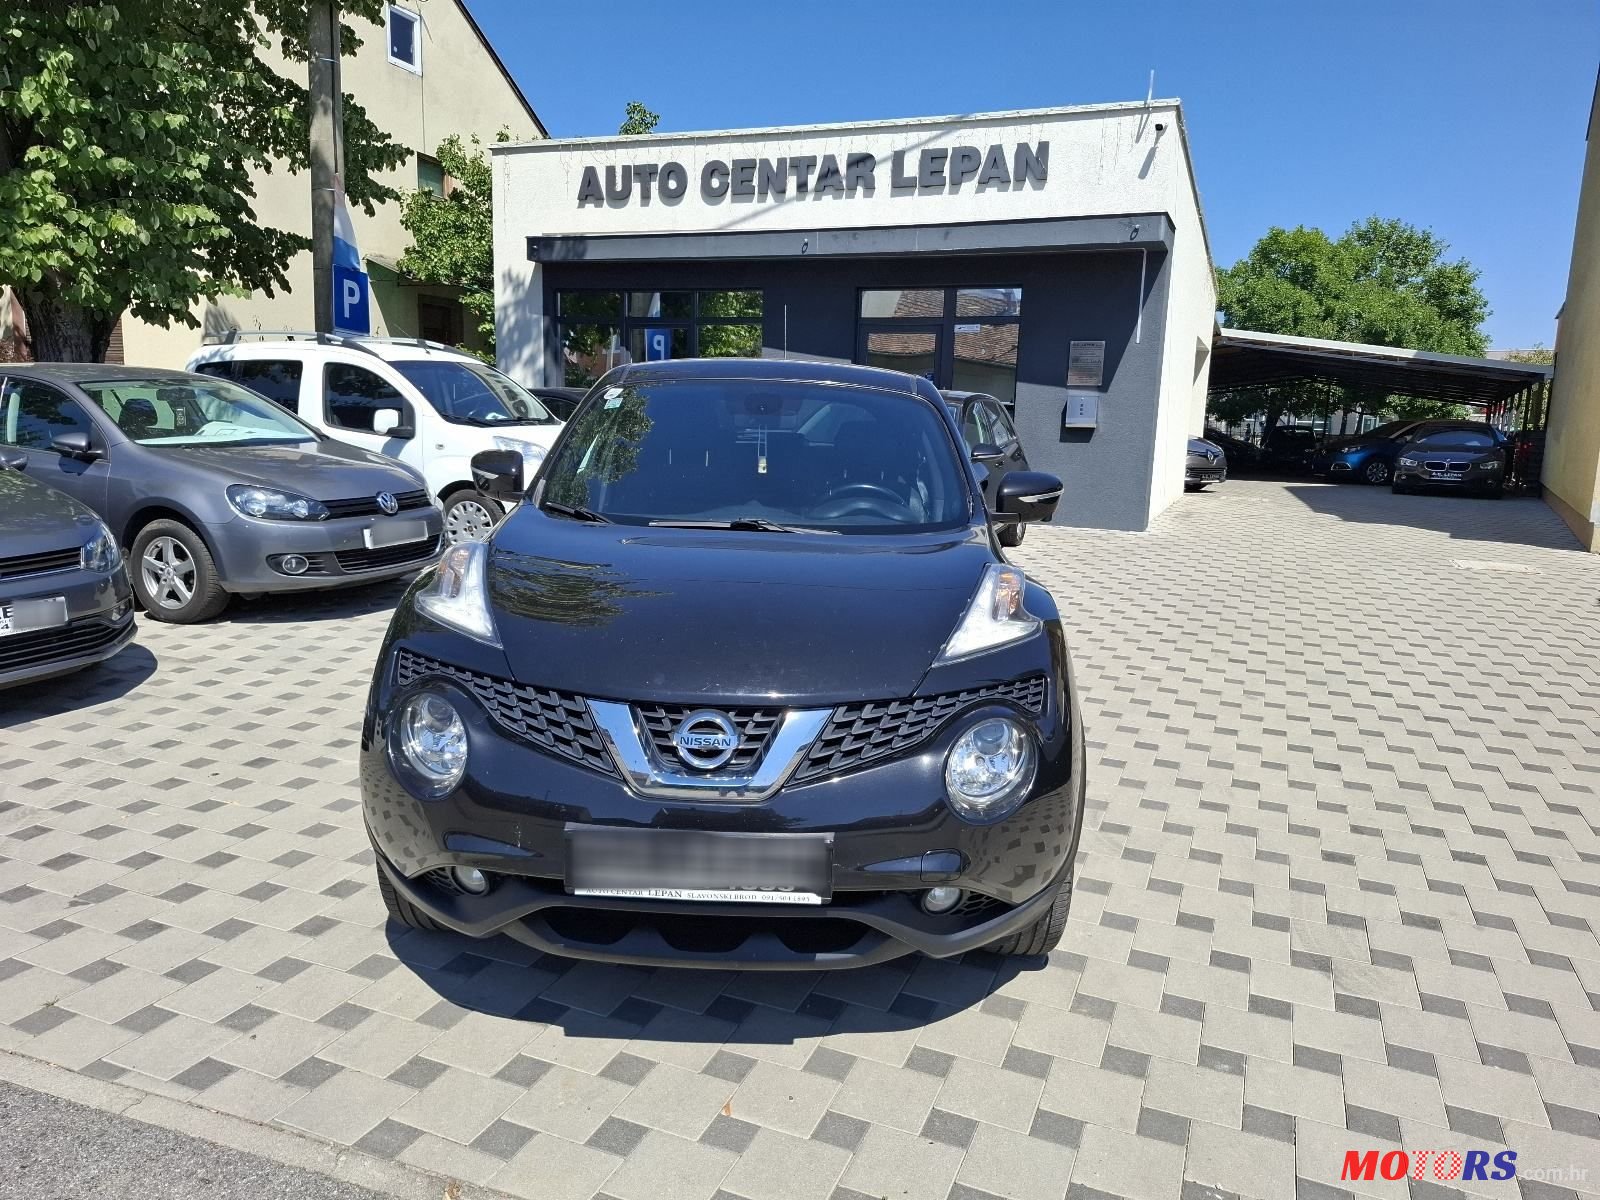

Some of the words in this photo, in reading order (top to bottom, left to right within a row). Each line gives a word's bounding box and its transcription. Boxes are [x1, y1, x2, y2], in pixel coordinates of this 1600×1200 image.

[576, 162, 688, 202] AUTO
[700, 152, 876, 199] CENTAR
[891, 141, 1049, 190] LEPAN
[343, 278, 360, 318] P
[680, 736, 731, 747] NISSAN
[648, 889, 682, 898] LEPAN
